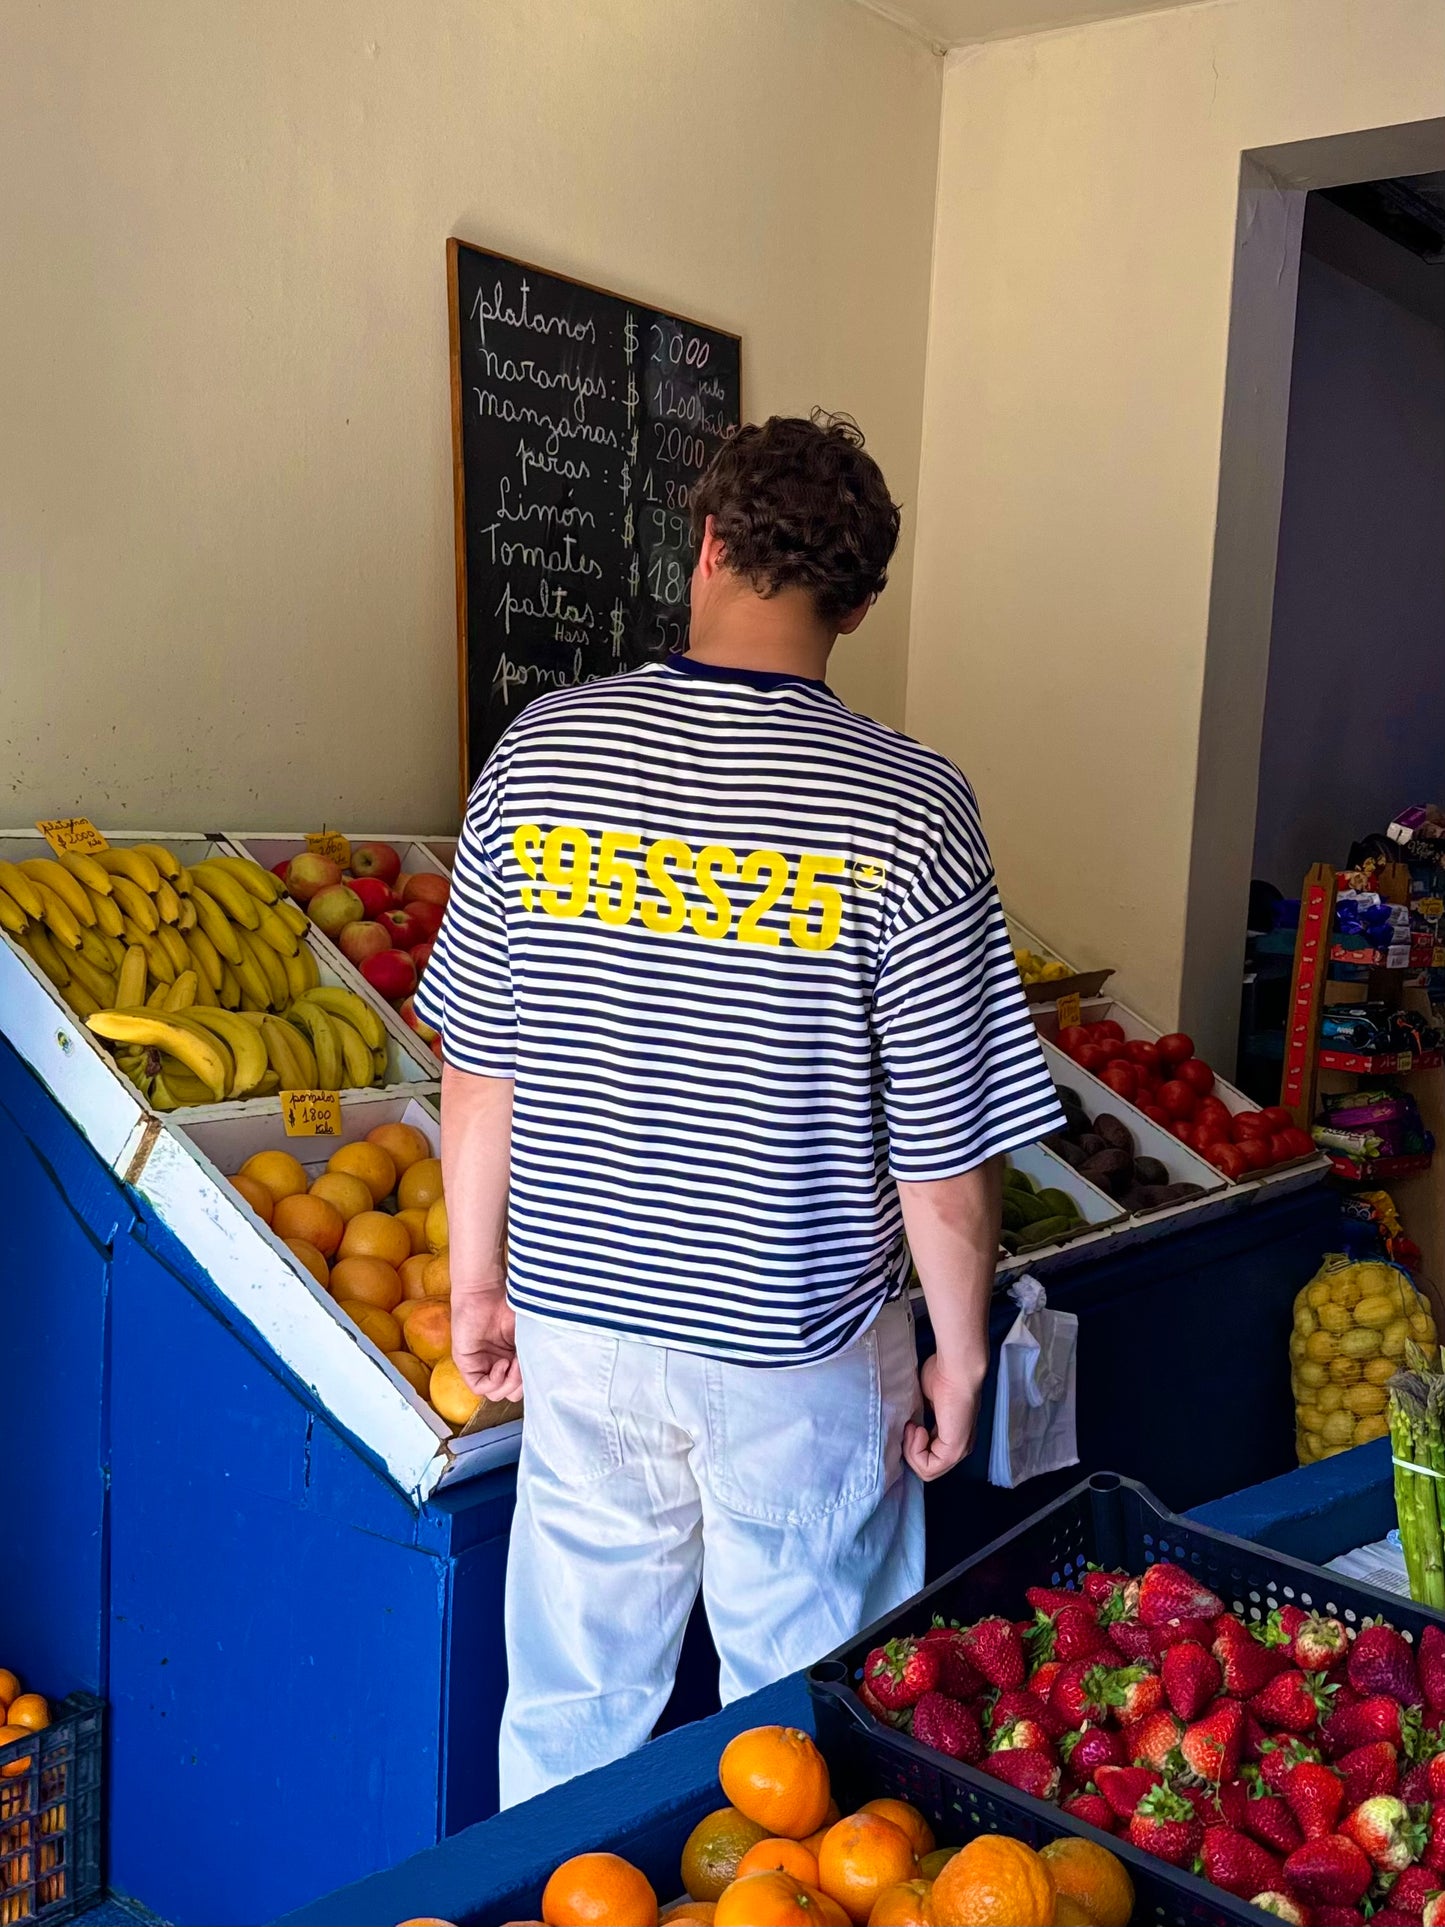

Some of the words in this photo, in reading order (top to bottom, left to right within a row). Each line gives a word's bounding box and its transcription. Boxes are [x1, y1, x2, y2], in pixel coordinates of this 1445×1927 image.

[470, 278, 596, 344] platanos
[623, 310, 639, 365] $
[650, 324, 710, 368] 2000
[622, 370, 640, 429] $
[653, 379, 696, 421] 1200
[654, 422, 705, 468] 2000
[619, 460, 632, 506] $
[620, 503, 635, 549] $
[627, 551, 640, 597] $
[609, 596, 625, 657] $
[648, 614, 690, 654] 52
[65, 831, 95, 844] 2000
[302, 1106, 332, 1124] 1800
